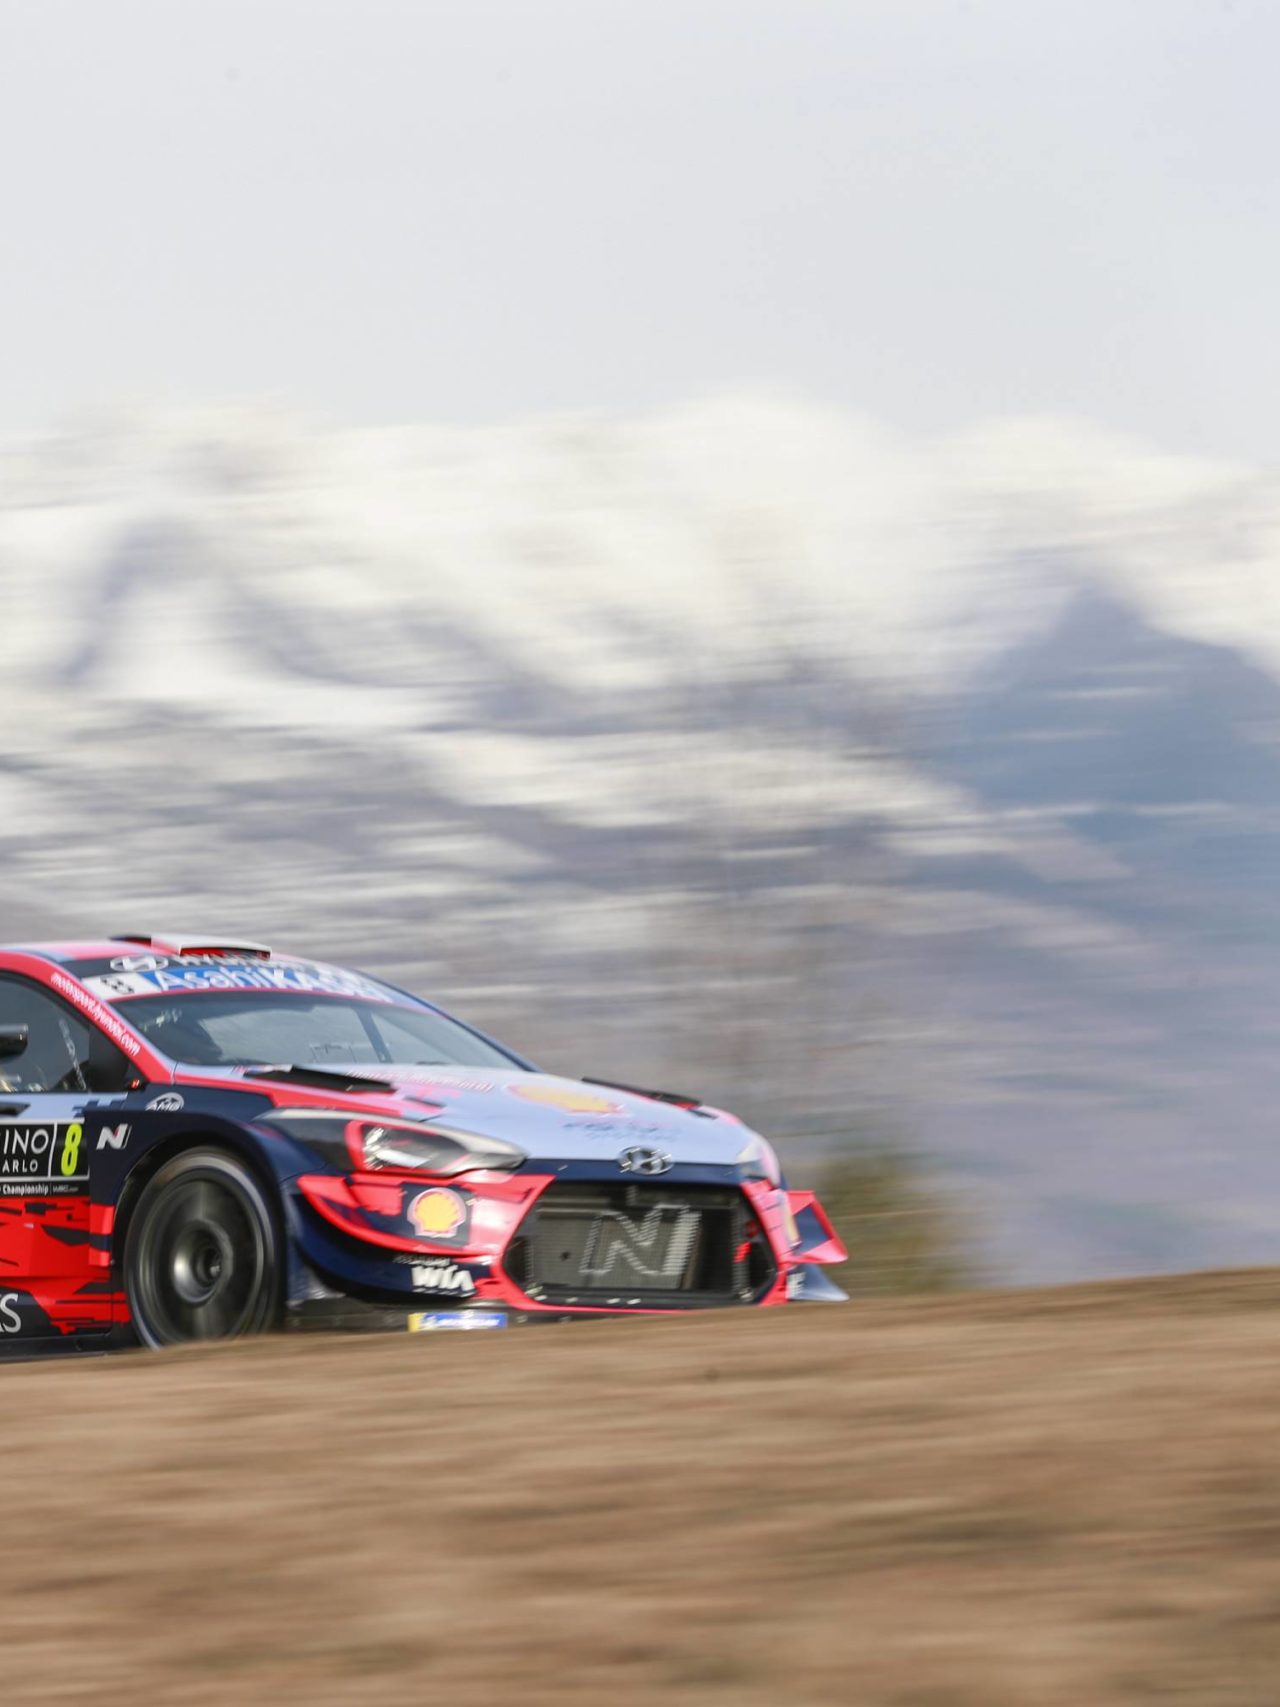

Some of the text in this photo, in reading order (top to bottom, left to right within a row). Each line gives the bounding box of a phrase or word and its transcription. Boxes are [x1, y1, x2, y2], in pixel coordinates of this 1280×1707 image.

[153, 966, 393, 1003] AsahiKA
[60, 1122, 83, 1176] 8
[2, 1182, 49, 1197] Championship
